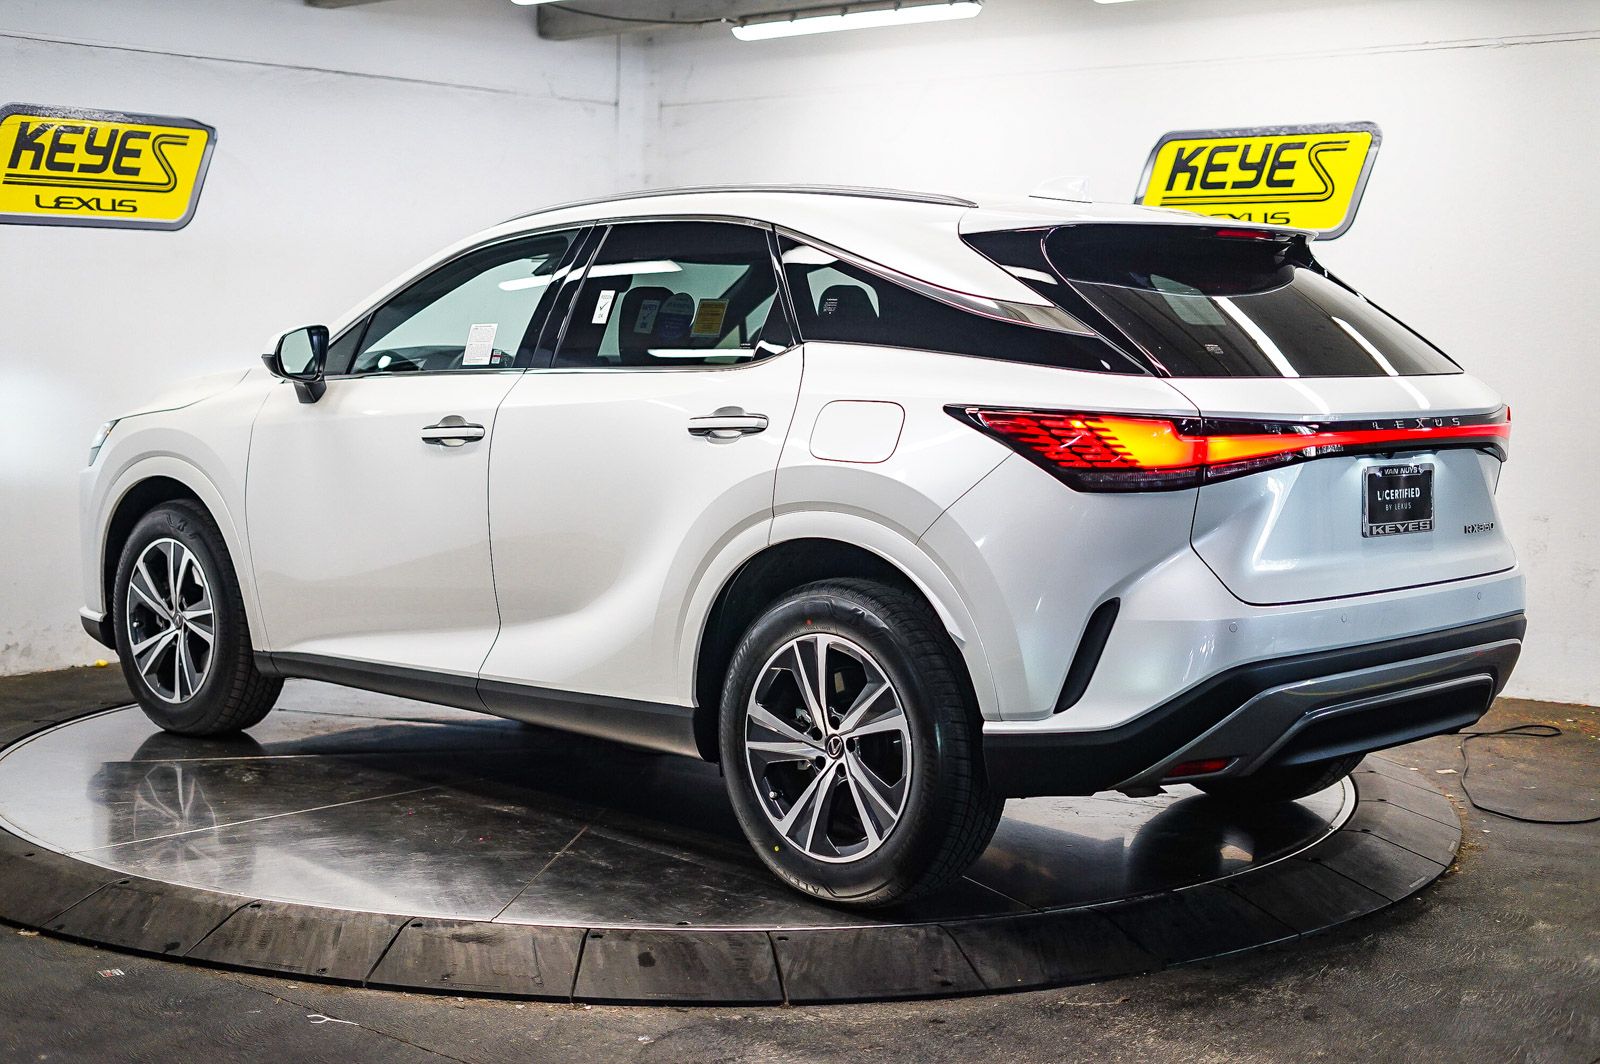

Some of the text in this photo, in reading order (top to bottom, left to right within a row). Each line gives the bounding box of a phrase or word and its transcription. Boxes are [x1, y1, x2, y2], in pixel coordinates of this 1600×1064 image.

[3, 121, 189, 193] KEYES
[1160, 140, 1350, 205] KEYES
[34, 194, 138, 213] LEXUS
[1372, 417, 1460, 430] LEXUS
[1384, 467, 1399, 475] VAN
[1385, 502, 1412, 511] BY LEXUS
[1372, 521, 1431, 535] KEYES
